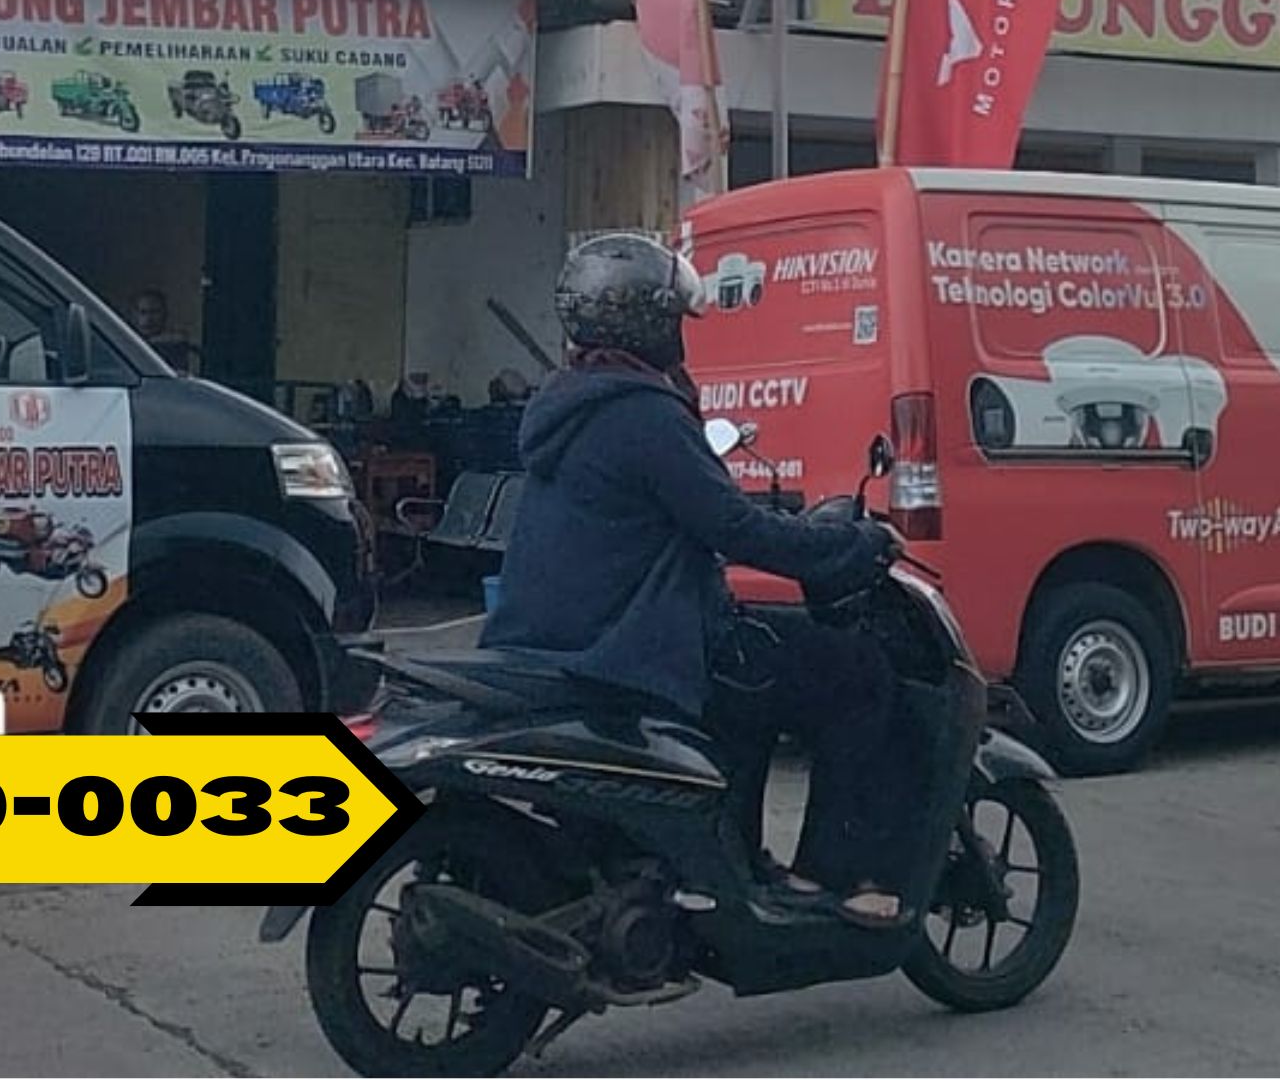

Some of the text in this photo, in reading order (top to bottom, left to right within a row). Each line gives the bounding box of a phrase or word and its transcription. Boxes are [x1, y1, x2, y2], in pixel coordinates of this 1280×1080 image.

[100, 40, 251, 61] PEMELIHARAAN
[280, 47, 329, 64] SUKU
[335, 50, 408, 68] CADANG
[773, 248, 878, 282] HIKVISION
[1027, 248, 1129, 275] Network
[1166, 284, 1206, 308] 3.0
[699, 377, 807, 411] BUDI CCTV
[33, 447, 122, 498] PUTRA
[1220, 612, 1276, 640] BUDI
